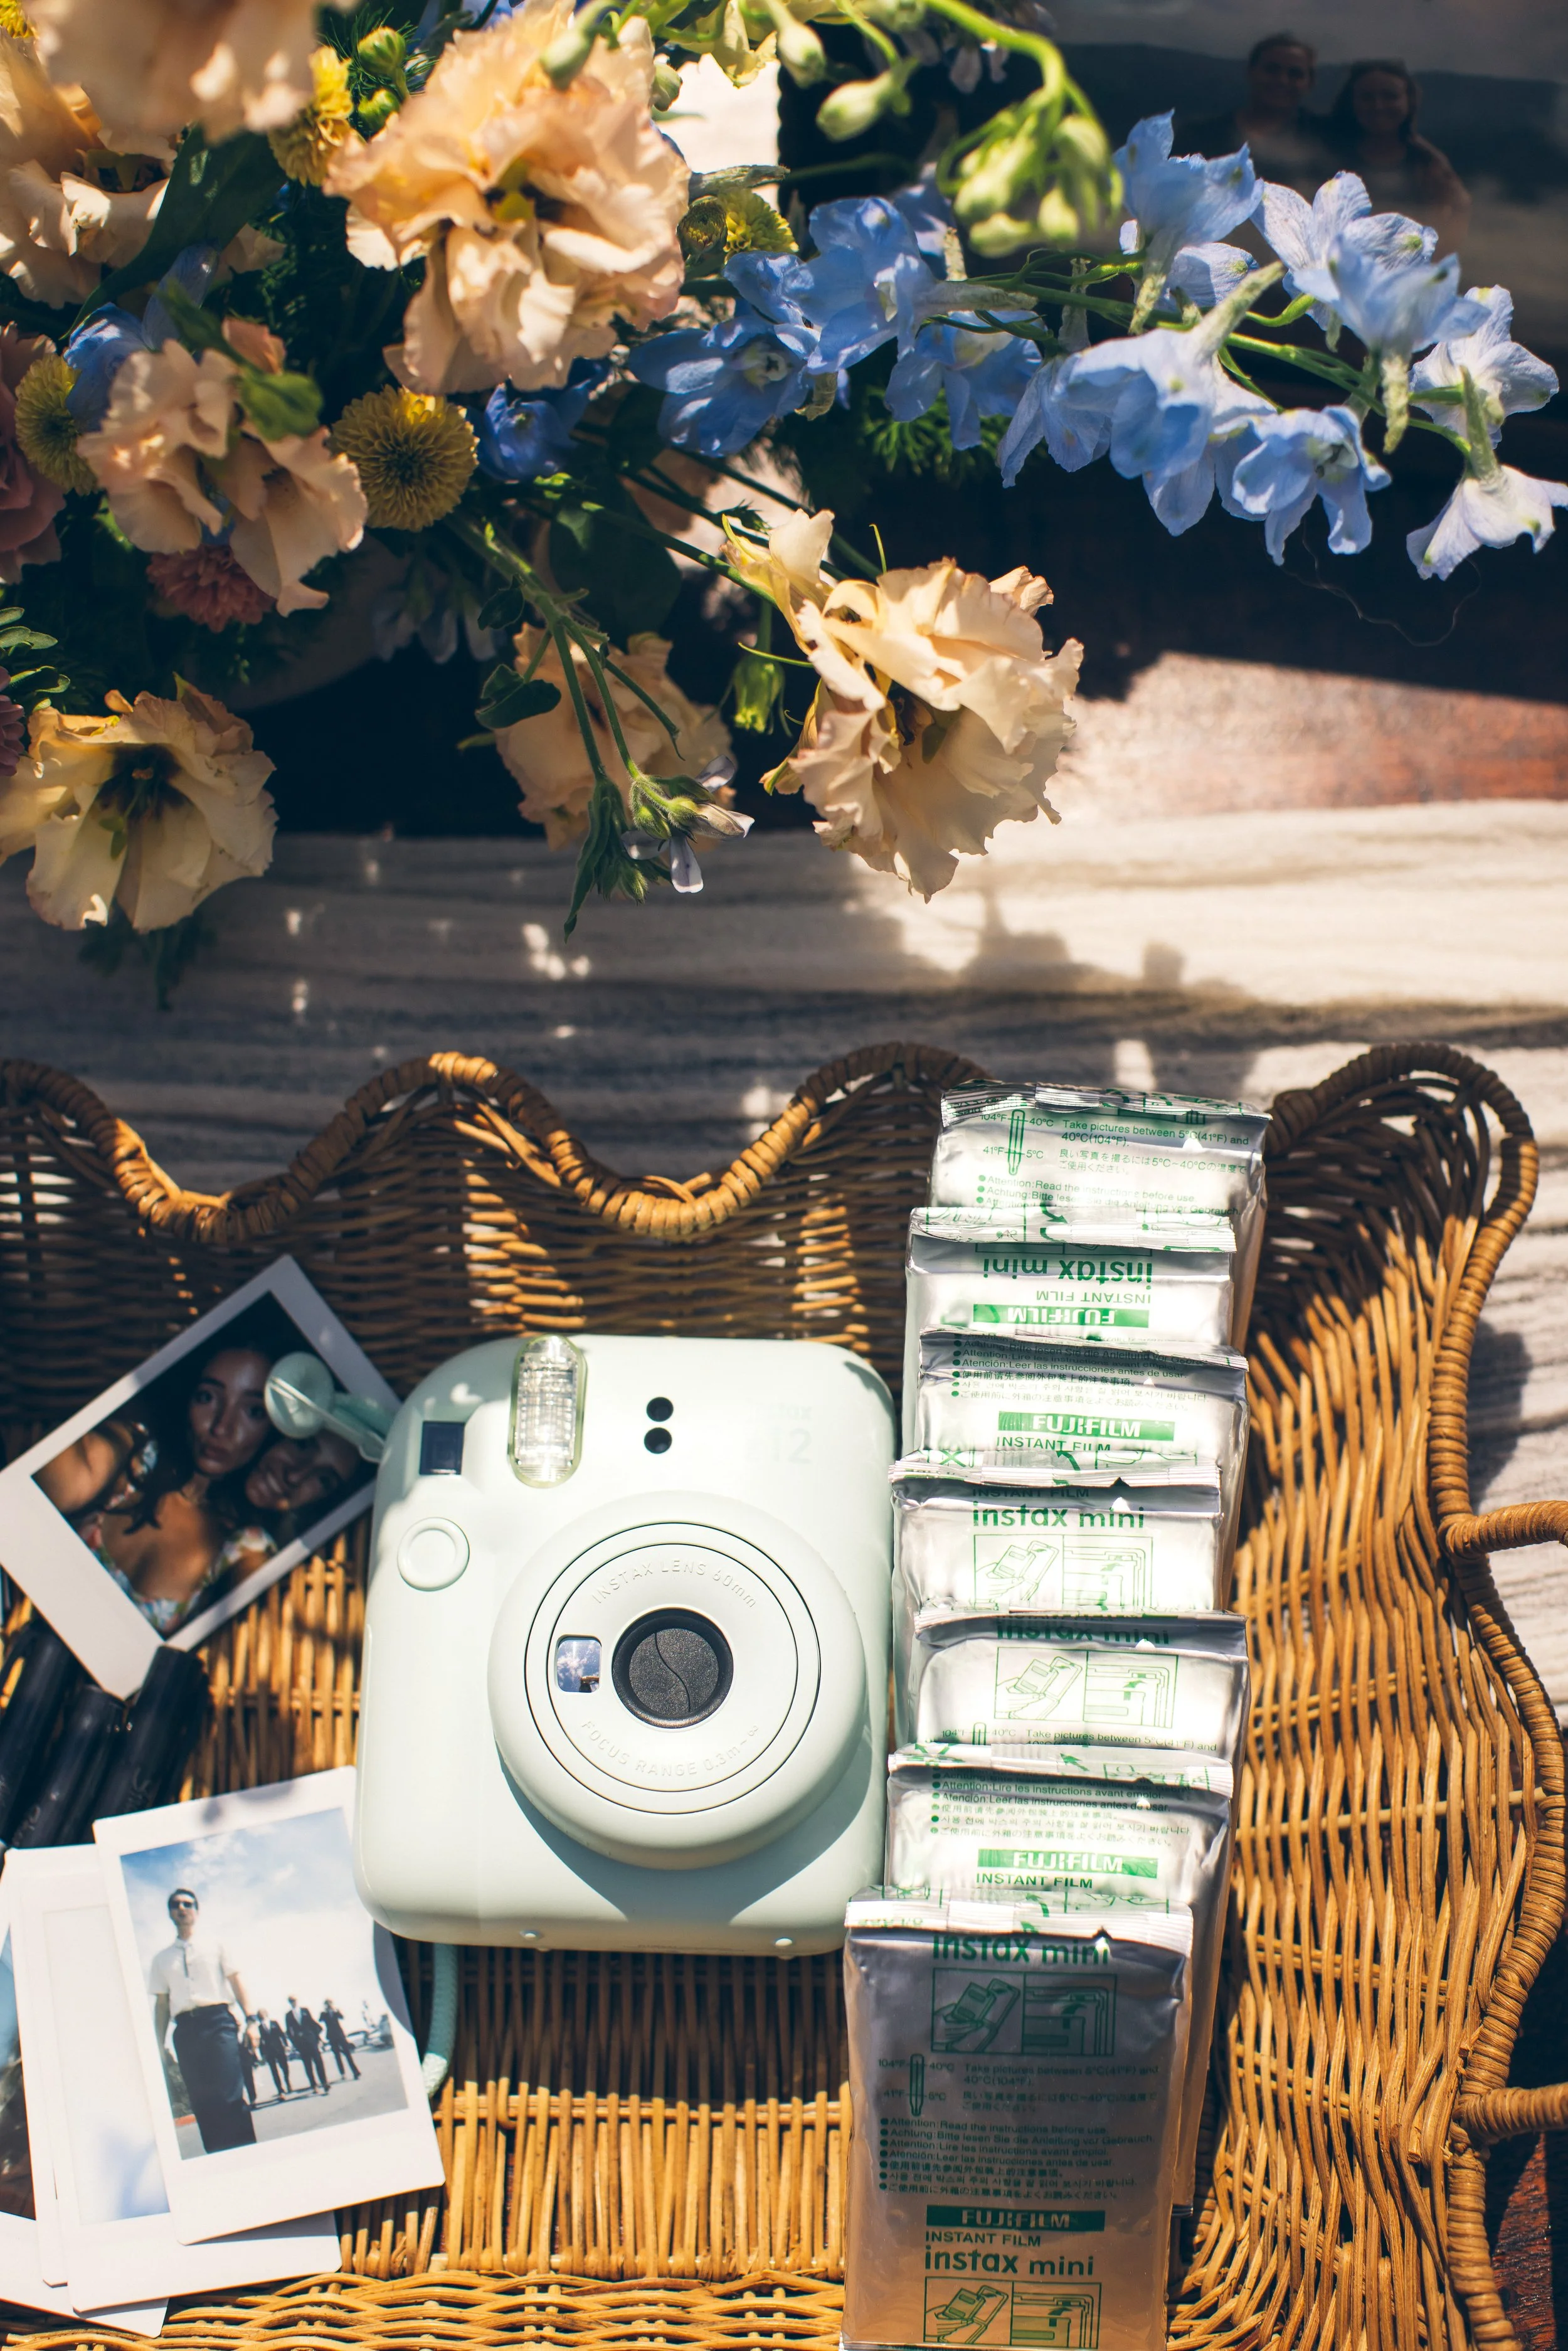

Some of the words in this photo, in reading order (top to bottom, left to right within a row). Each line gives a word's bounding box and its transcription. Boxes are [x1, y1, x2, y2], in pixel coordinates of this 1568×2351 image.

[1029, 1118, 1054, 1127] 40°C
[1062, 1120, 1088, 1130] Take
[1090, 1123, 1130, 1134] pictures
[1133, 1126, 1175, 1138] between
[1230, 1137, 1249, 1145] and
[983, 1147, 1005, 1155] 41°F
[1025, 1149, 1044, 1159] 5°C
[1056, 1194, 1083, 1203] lese
[1064, 1183, 1081, 1192] the
[1143, 1191, 1174, 1201] before
[983, 1258, 1047, 1280] mini
[1059, 1260, 1153, 1290] instax
[1036, 1290, 1074, 1302] FILM
[1081, 1292, 1151, 1303] INSTANT
[1007, 1307, 1117, 1325] FUJIFILM
[1034, 1354, 1049, 1362] les
[1051, 1355, 1110, 1366] instructions
[1112, 1360, 1140, 1368] avant
[1084, 1350, 1100, 1358] die
[1034, 1362, 1048, 1370] las
[1051, 1363, 1115, 1374] instrucciones
[1118, 1367, 1145, 1377] antes
[1147, 1369, 1160, 1377] de
[1162, 1371, 1187, 1379] usar.
[1032, 1414, 1141, 1437] FUJIFILM
[996, 1436, 1068, 1451] INSTANT
[1073, 1442, 1111, 1451] FILM
[973, 1487, 1042, 1498] INSTANT
[1050, 1487, 1089, 1498] FILM
[973, 1501, 1068, 1527] instax
[1079, 1507, 1145, 1529] mini
[591, 1561, 654, 1605] INSTAX
[661, 1559, 707, 1576] LENS
[711, 1569, 757, 1609] 60mm
[996, 1620, 1093, 1641] instax
[1104, 1628, 1170, 1644] mini
[1027, 1729, 1051, 1738] Take
[1054, 1732, 1094, 1741] pictures
[1097, 1733, 1142, 1744] between
[1197, 1743, 1217, 1752] and
[581, 1721, 630, 1766] FOCUS
[635, 1759, 698, 1777] RANGE
[1015, 1785, 1030, 1793] les
[1032, 1785, 1093, 1796] instructions
[1095, 1788, 1125, 1798] avant
[1014, 1796, 1029, 1805] las
[1032, 1796, 1098, 1808] instrucciones
[1099, 1800, 1128, 1810] antes
[1013, 1851, 1123, 1872] FUJIFILM
[976, 1872, 1048, 1887] INSTANT
[1053, 1877, 1093, 1889] FILM
[933, 1935, 1030, 1963] instax
[1042, 1939, 1110, 1965] mini
[965, 2062, 990, 2073] Take
[993, 2064, 1034, 2076] pictures
[970, 2123, 987, 2131] the
[990, 2123, 1049, 2134] instructions
[1051, 2125, 1084, 2134] before
[963, 2133, 990, 2143] lesen
[993, 2134, 1010, 2143] Sie
[1013, 2135, 1029, 2145] die
[1032, 2136, 1080, 2148] Anleitung
[961, 2143, 977, 2153] les
[979, 2145, 1037, 2156] instructions
[1041, 2147, 1069, 2156] avant
[961, 2154, 976, 2163] las
[978, 2154, 1043, 2165] instrucciones
[1046, 2158, 1073, 2167] antes
[1076, 2158, 1088, 2167] de
[961, 2209, 1070, 2229] FUJIFILM
[925, 2231, 997, 2245] INSTANT
[1002, 2234, 1041, 2247] FILM
[925, 2245, 1019, 2274] instax
[1029, 2256, 1094, 2276] mini
